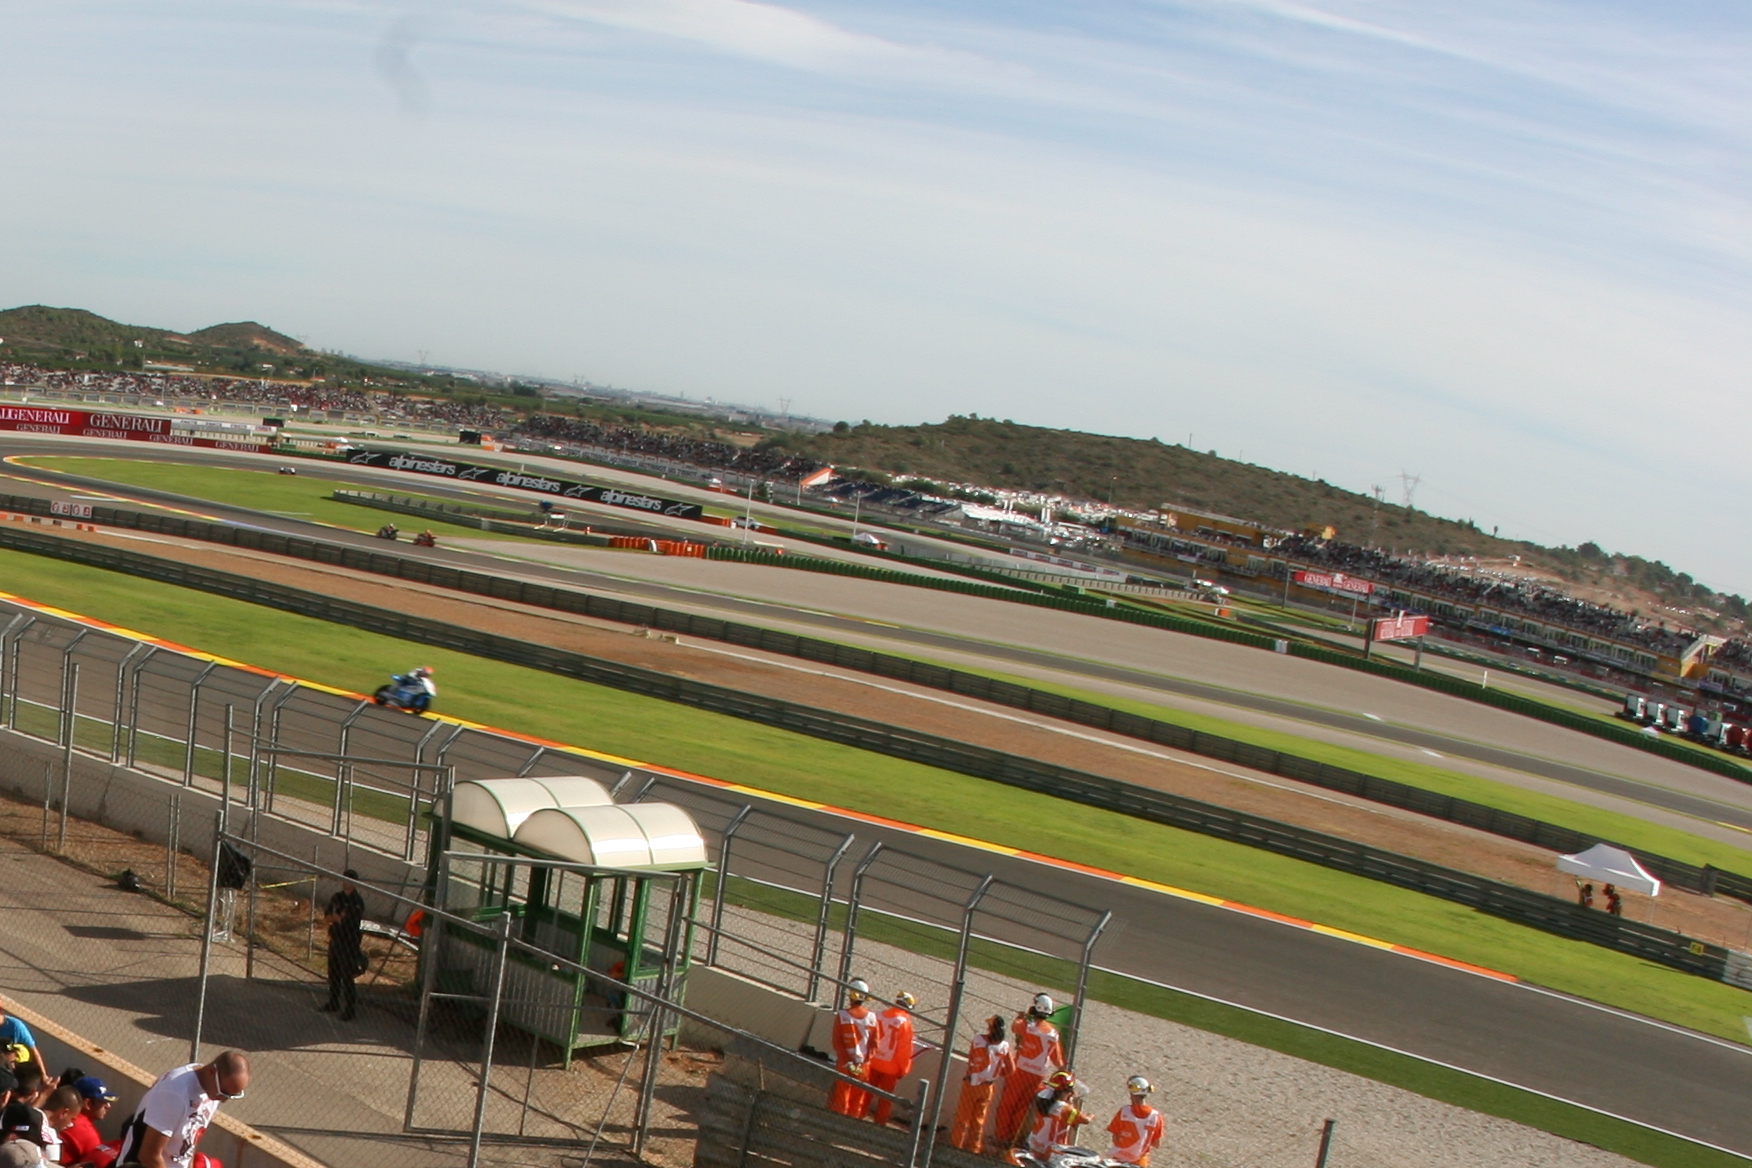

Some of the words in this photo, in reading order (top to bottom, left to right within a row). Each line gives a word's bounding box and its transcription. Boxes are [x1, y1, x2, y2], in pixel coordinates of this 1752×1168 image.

[9, 408, 71, 424] GENERALI
[90, 414, 163, 433] GENERALI
[16, 423, 61, 434] GENERALI
[82, 428, 127, 439] GENERALI
[149, 433, 193, 446] GENERALI
[215, 440, 259, 452] GENERALI
[388, 454, 456, 476] alpinestars
[496, 470, 561, 493] alpinestars
[600, 488, 662, 512] alpinestars
